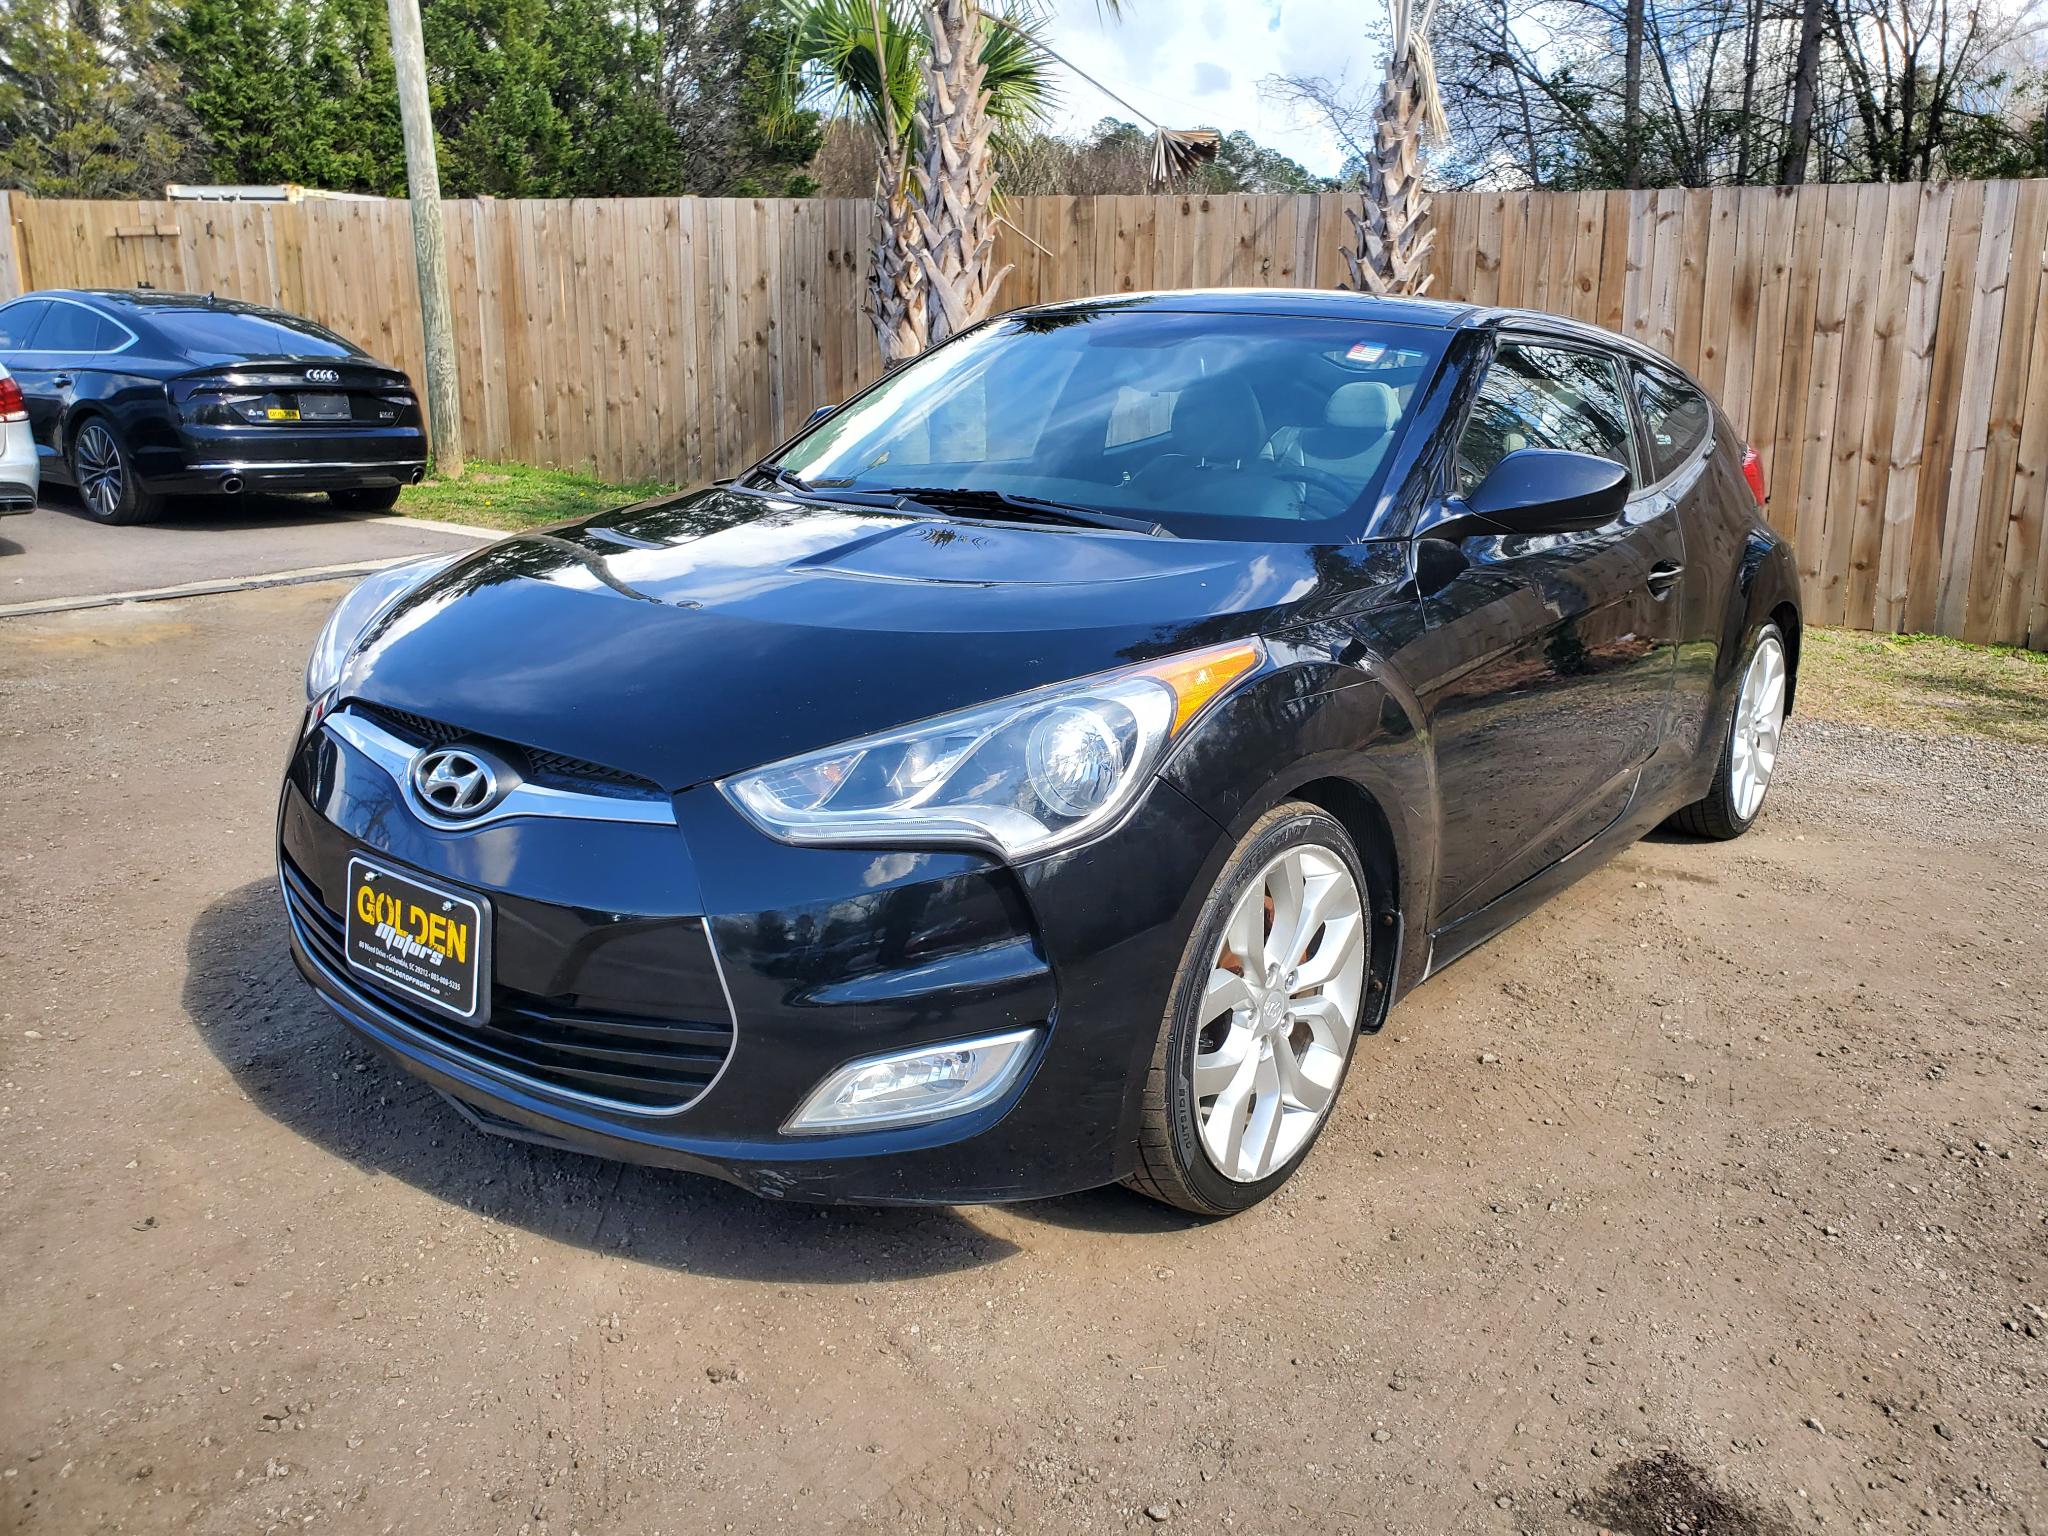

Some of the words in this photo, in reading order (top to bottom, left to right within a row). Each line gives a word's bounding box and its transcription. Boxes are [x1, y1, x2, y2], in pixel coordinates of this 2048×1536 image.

[357, 885, 467, 964] GOLDEN
[375, 922, 444, 967] Motors
[1178, 1088, 1192, 1150] OUTSIDE
